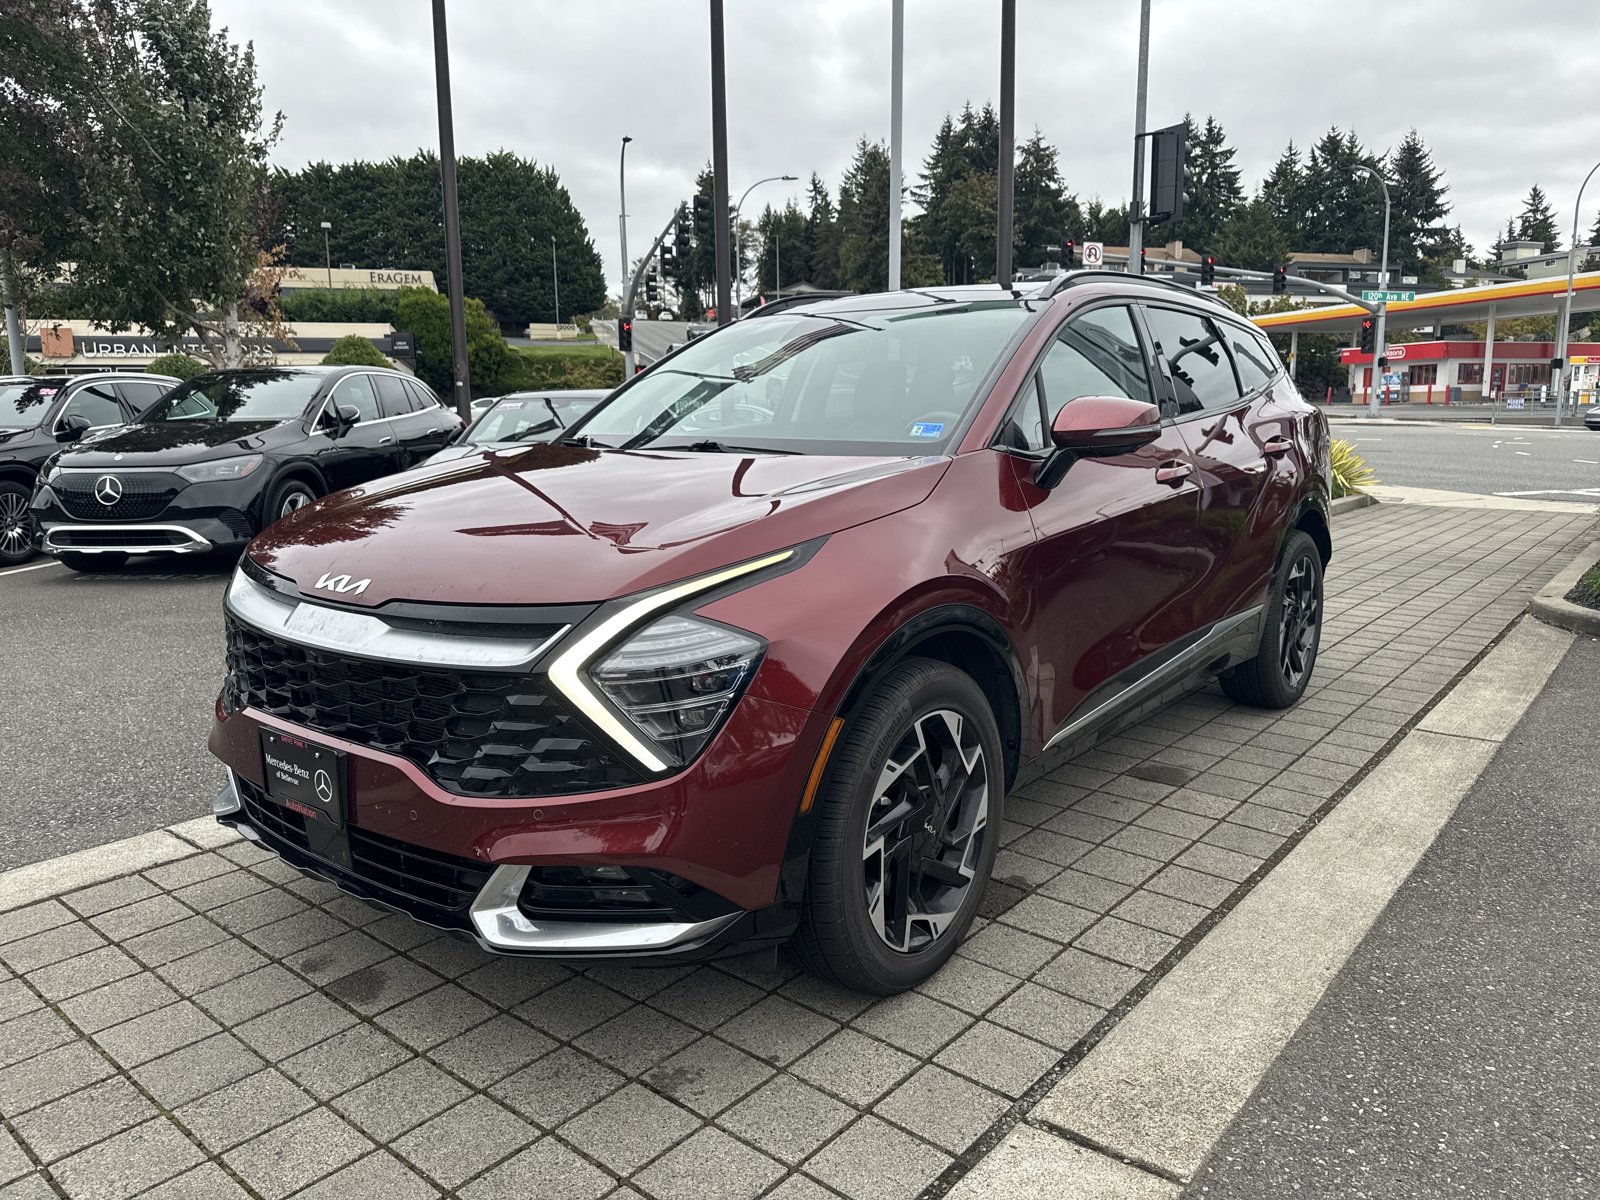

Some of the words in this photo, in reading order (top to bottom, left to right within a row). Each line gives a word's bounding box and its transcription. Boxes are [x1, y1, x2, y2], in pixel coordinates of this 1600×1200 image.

[82, 342, 156, 358] URBAN
[314, 572, 372, 596] KIA
[265, 752, 310, 780] Mercedes-Benz
[285, 799, 316, 818] AutoNation
